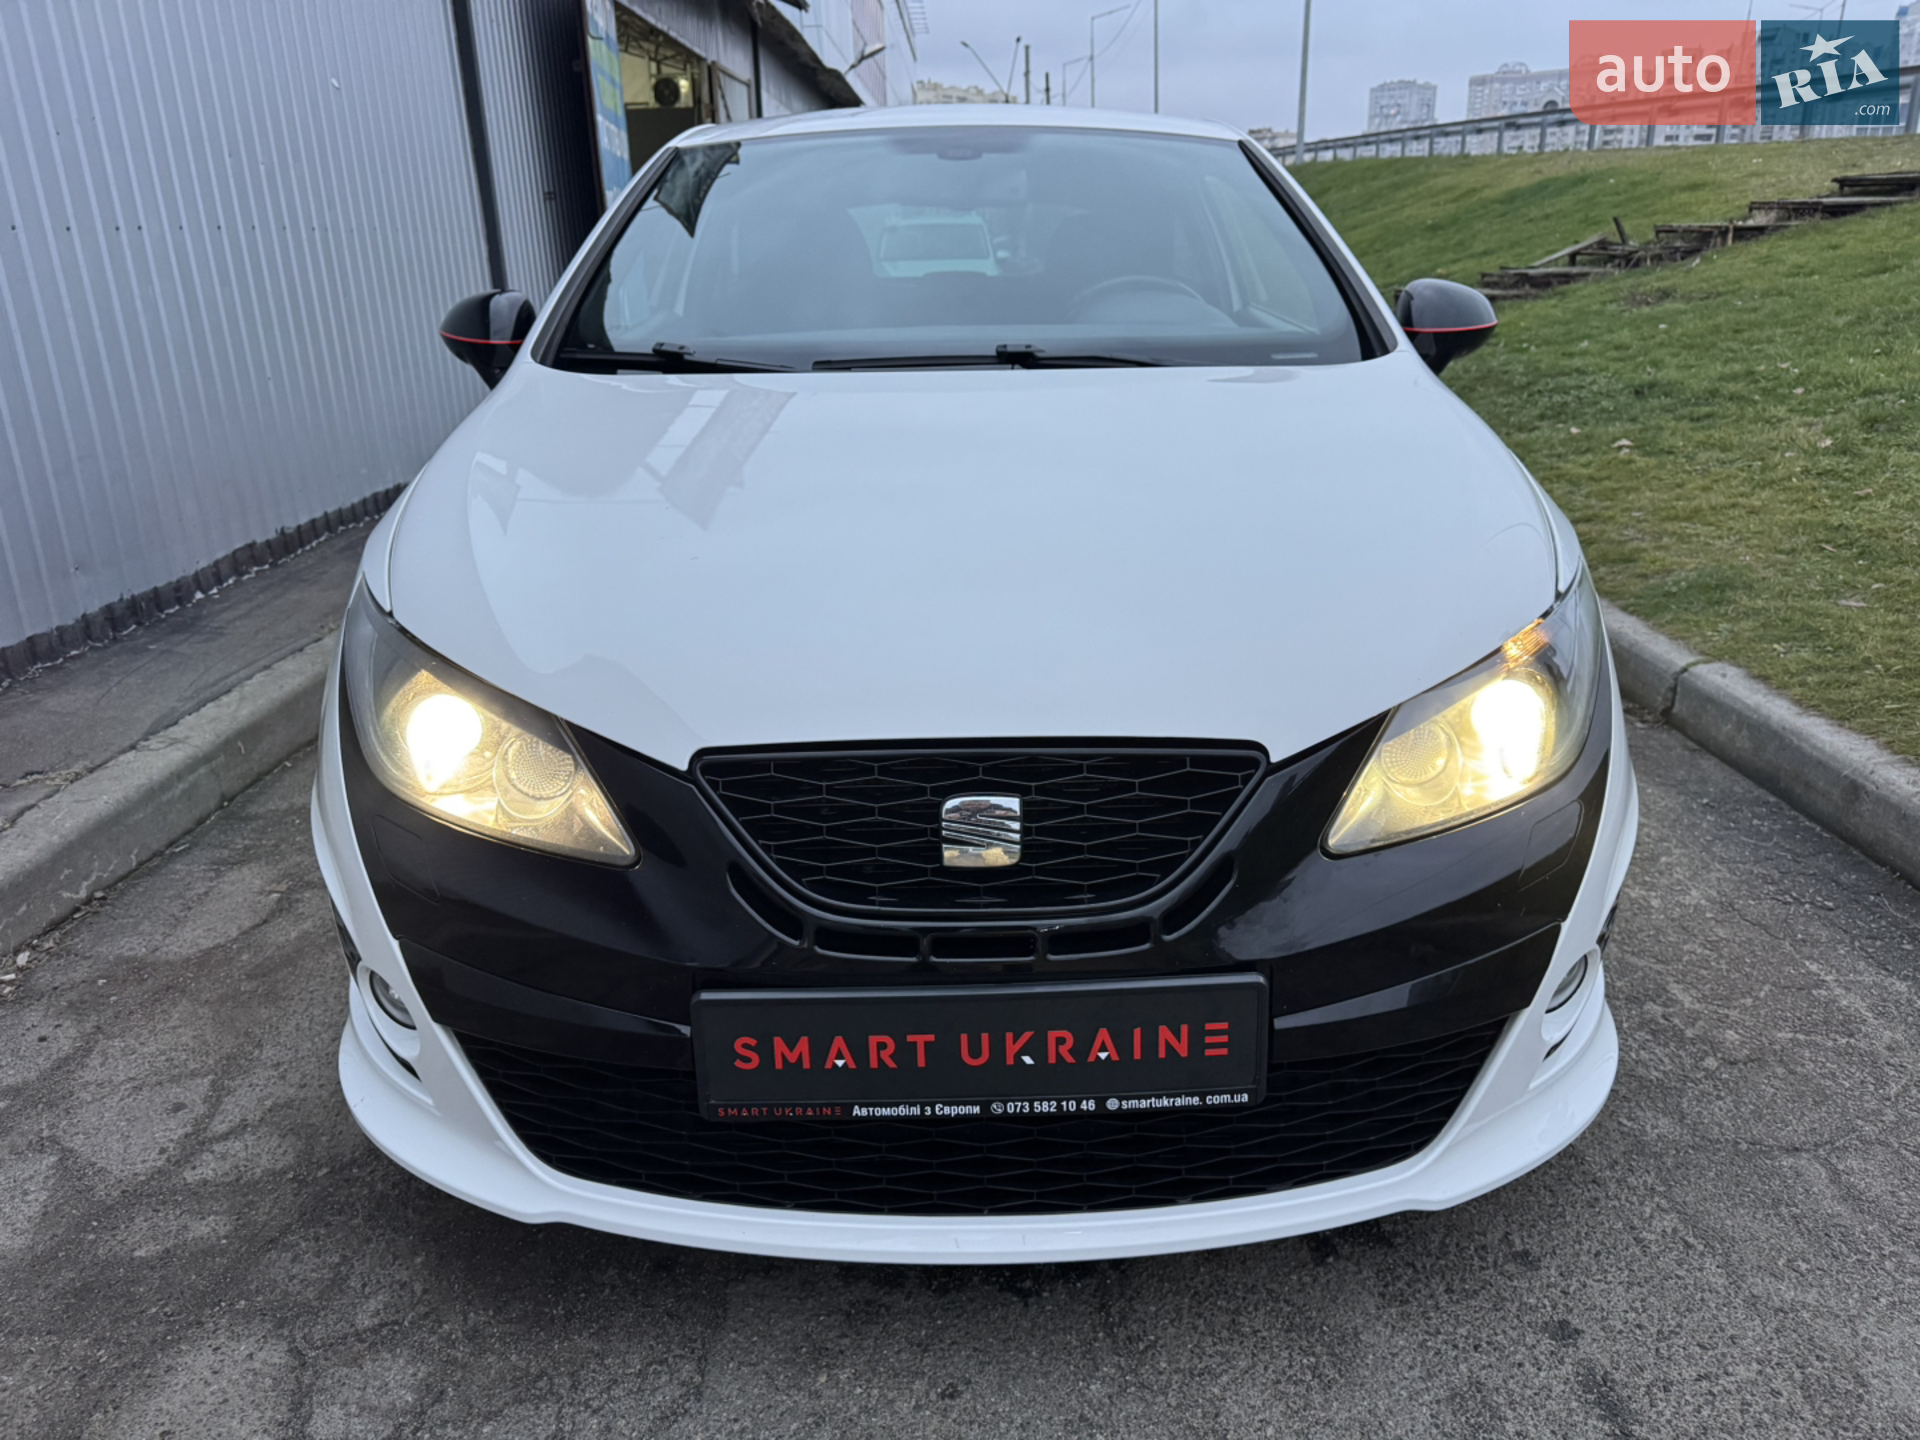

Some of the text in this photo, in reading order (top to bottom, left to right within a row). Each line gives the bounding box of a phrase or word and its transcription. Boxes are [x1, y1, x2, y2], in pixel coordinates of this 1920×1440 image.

[733, 1022, 1229, 1070] SMART UKRAINE
[717, 1106, 843, 1117] SMART UKRAINE
[852, 1104, 981, 1117] Автомобілі з Європи
[1006, 1100, 1096, 1113] 073 582 10 46
